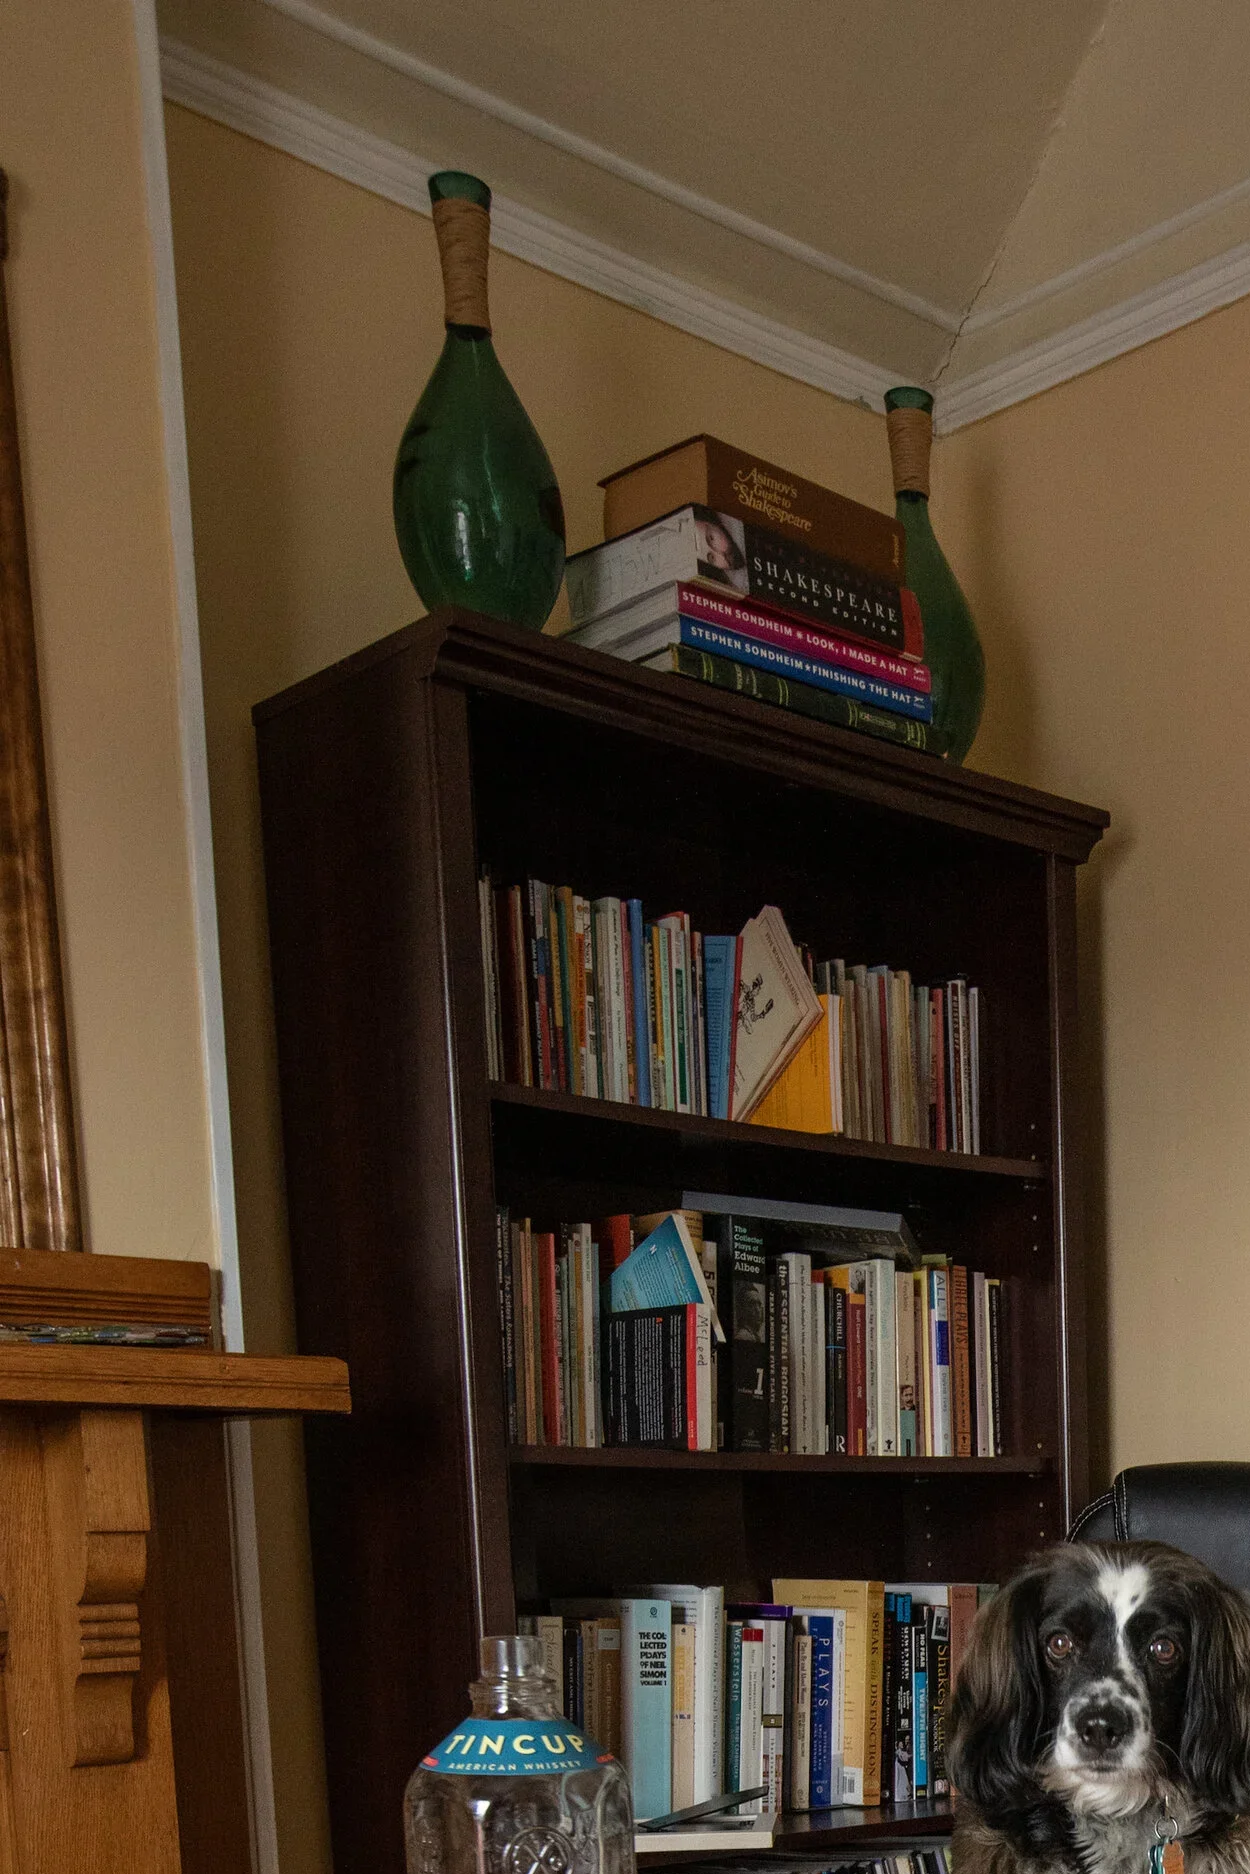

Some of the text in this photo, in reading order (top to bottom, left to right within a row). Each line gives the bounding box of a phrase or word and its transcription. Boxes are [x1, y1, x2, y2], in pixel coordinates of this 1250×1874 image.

[735, 467, 798, 499] Asimov's
[733, 482, 812, 531] Shakespeare
[781, 496, 792, 507] to
[753, 556, 898, 624] SHAKESPEARE
[757, 579, 898, 635] SECOND EDITION
[682, 591, 732, 617] STEPHEN
[735, 609, 793, 637] SONDHEIM
[806, 633, 839, 654] LOOK,
[848, 644, 879, 666] MADE
[879, 657, 886, 668] A
[888, 661, 908, 677] HAT
[690, 625, 911, 704] STEPHEN SONDHEIM FINISHING THE HAT
[734, 1224, 748, 1234] The
[734, 1233, 764, 1245] Collected
[734, 1242, 752, 1252] Plays
[734, 1251, 766, 1265] Edward
[734, 1262, 760, 1274] Albee
[937, 1275, 946, 1307] ALL
[956, 1311, 968, 1344] PLAYS
[778, 1264, 789, 1436] the ESSENTIAL BOGOSIAN
[754, 1368, 765, 1396] 1
[639, 1632, 651, 1640] THE
[871, 1611, 880, 1655] SPEAK
[919, 1633, 926, 1646] NO
[640, 1641, 667, 1650] LECTED
[800, 1641, 808, 1655] Plays
[587, 1651, 595, 1668] Fool
[640, 1651, 667, 1659] PLAYS
[639, 1661, 667, 1669] OF NEIL
[732, 1628, 741, 1702] Wasserstein
[818, 1638, 830, 1707] PLAYS
[640, 1671, 667, 1679] SIMON
[800, 1672, 808, 1687] About
[712, 1684, 719, 1693] of
[869, 1684, 878, 1777] DISTINCTION
[444, 1734, 585, 1755] TINCUP
[447, 1760, 582, 1771] AMERICAN WHISKEY
